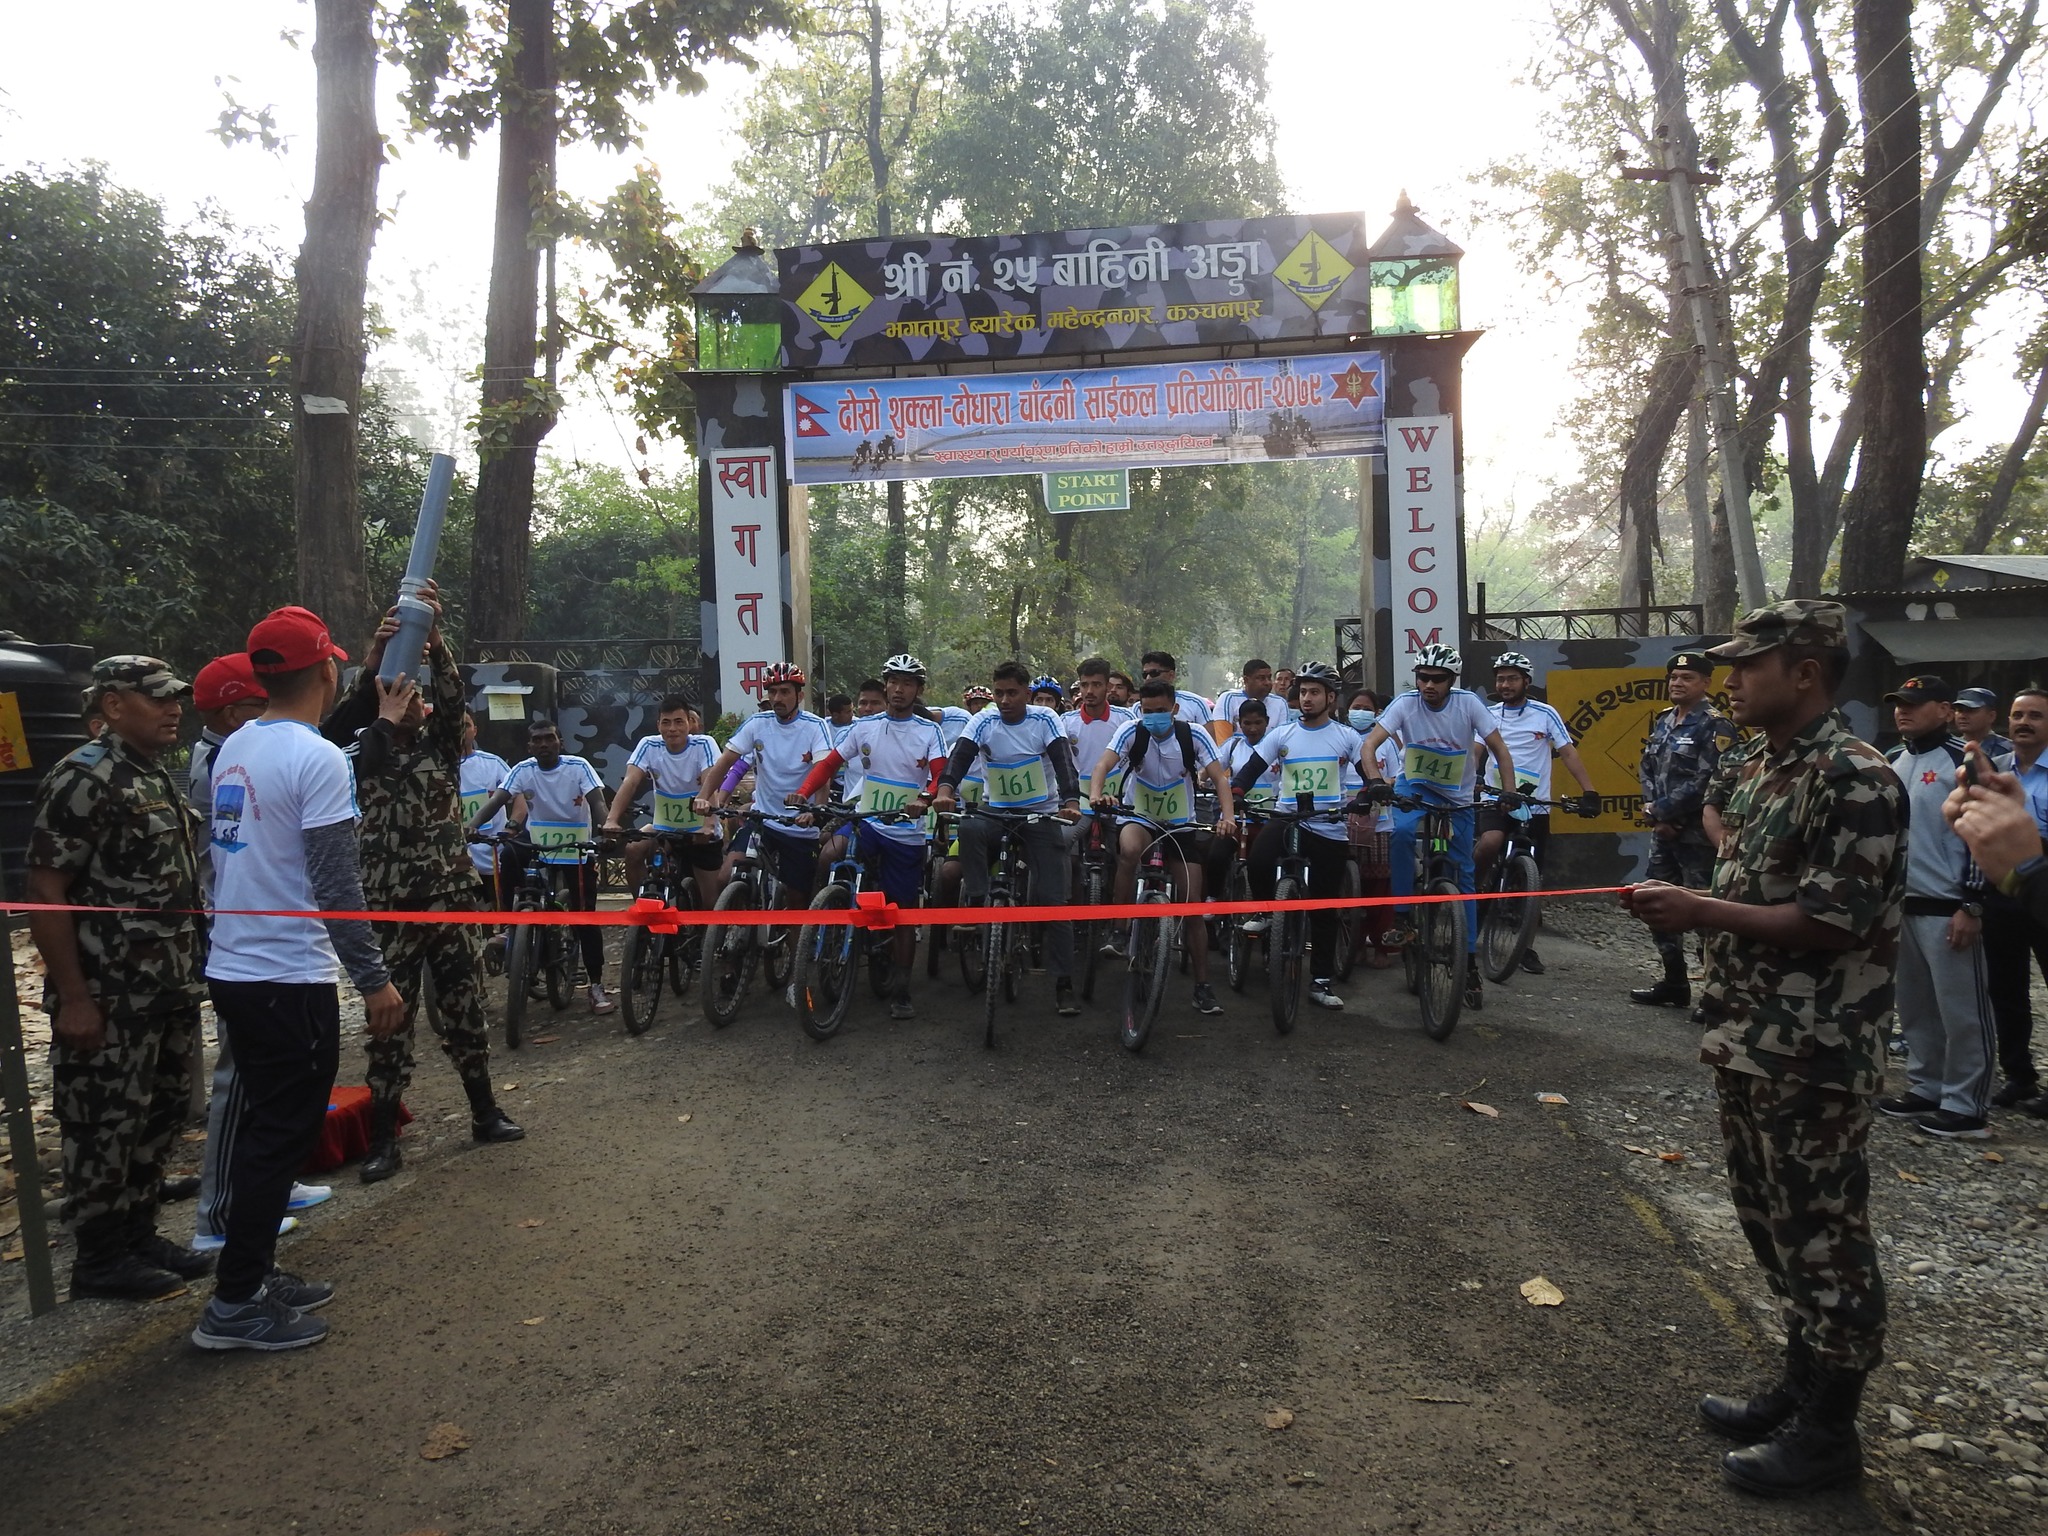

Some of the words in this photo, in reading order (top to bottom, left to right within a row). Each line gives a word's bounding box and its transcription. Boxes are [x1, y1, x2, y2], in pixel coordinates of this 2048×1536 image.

[883, 252, 929, 301] श्री
[940, 252, 981, 294] नं.
[993, 254, 1038, 294] २५
[1052, 237, 1172, 289] बाहिनी
[1184, 240, 1262, 297] अड्डा
[886, 318, 963, 341] भगतपुर
[1166, 299, 1263, 322] कञ्चनपुर
[1018, 377, 1077, 424] चाँदनी
[1083, 375, 1158, 426] साईकल
[989, 448, 1002, 463] र
[1104, 437, 1134, 455] हाम्रो
[1058, 474, 1119, 489] START
[1058, 492, 1119, 508] POINT
[1398, 425, 1443, 654] WELCOM
[1291, 767, 1329, 791] 132
[1412, 754, 1453, 780] 141
[998, 770, 1037, 796] 161
[663, 802, 698, 823] 121
[1144, 792, 1178, 816] 176
[539, 832, 577, 854] 122
